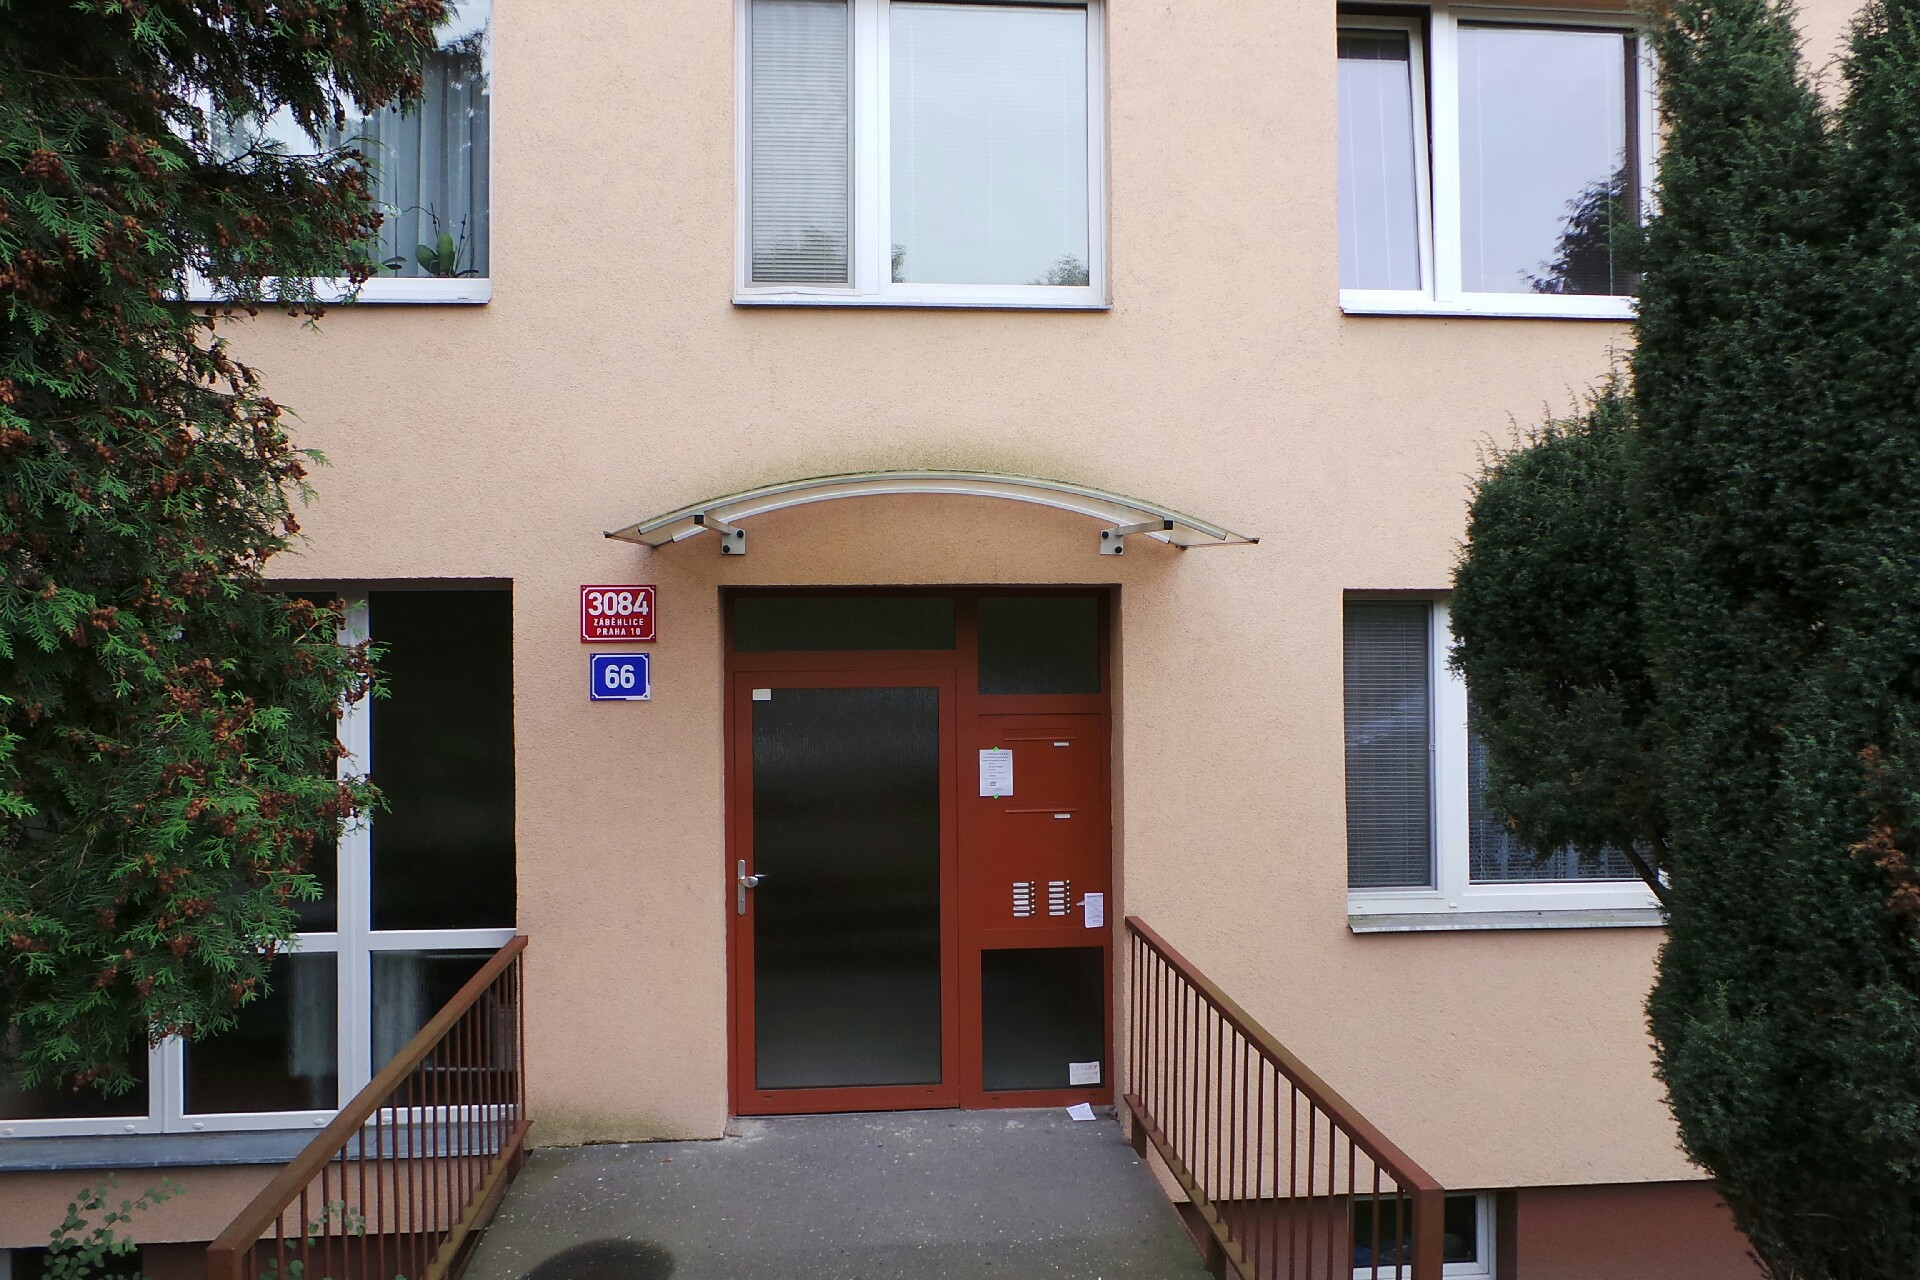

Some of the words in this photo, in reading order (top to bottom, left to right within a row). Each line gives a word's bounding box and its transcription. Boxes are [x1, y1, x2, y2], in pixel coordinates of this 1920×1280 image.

[588, 591, 648, 616] 3084
[593, 617, 644, 626] ZÁBĚHLICE
[596, 627, 626, 636] PRAHA
[631, 627, 641, 636] 10
[605, 664, 635, 689] 66
